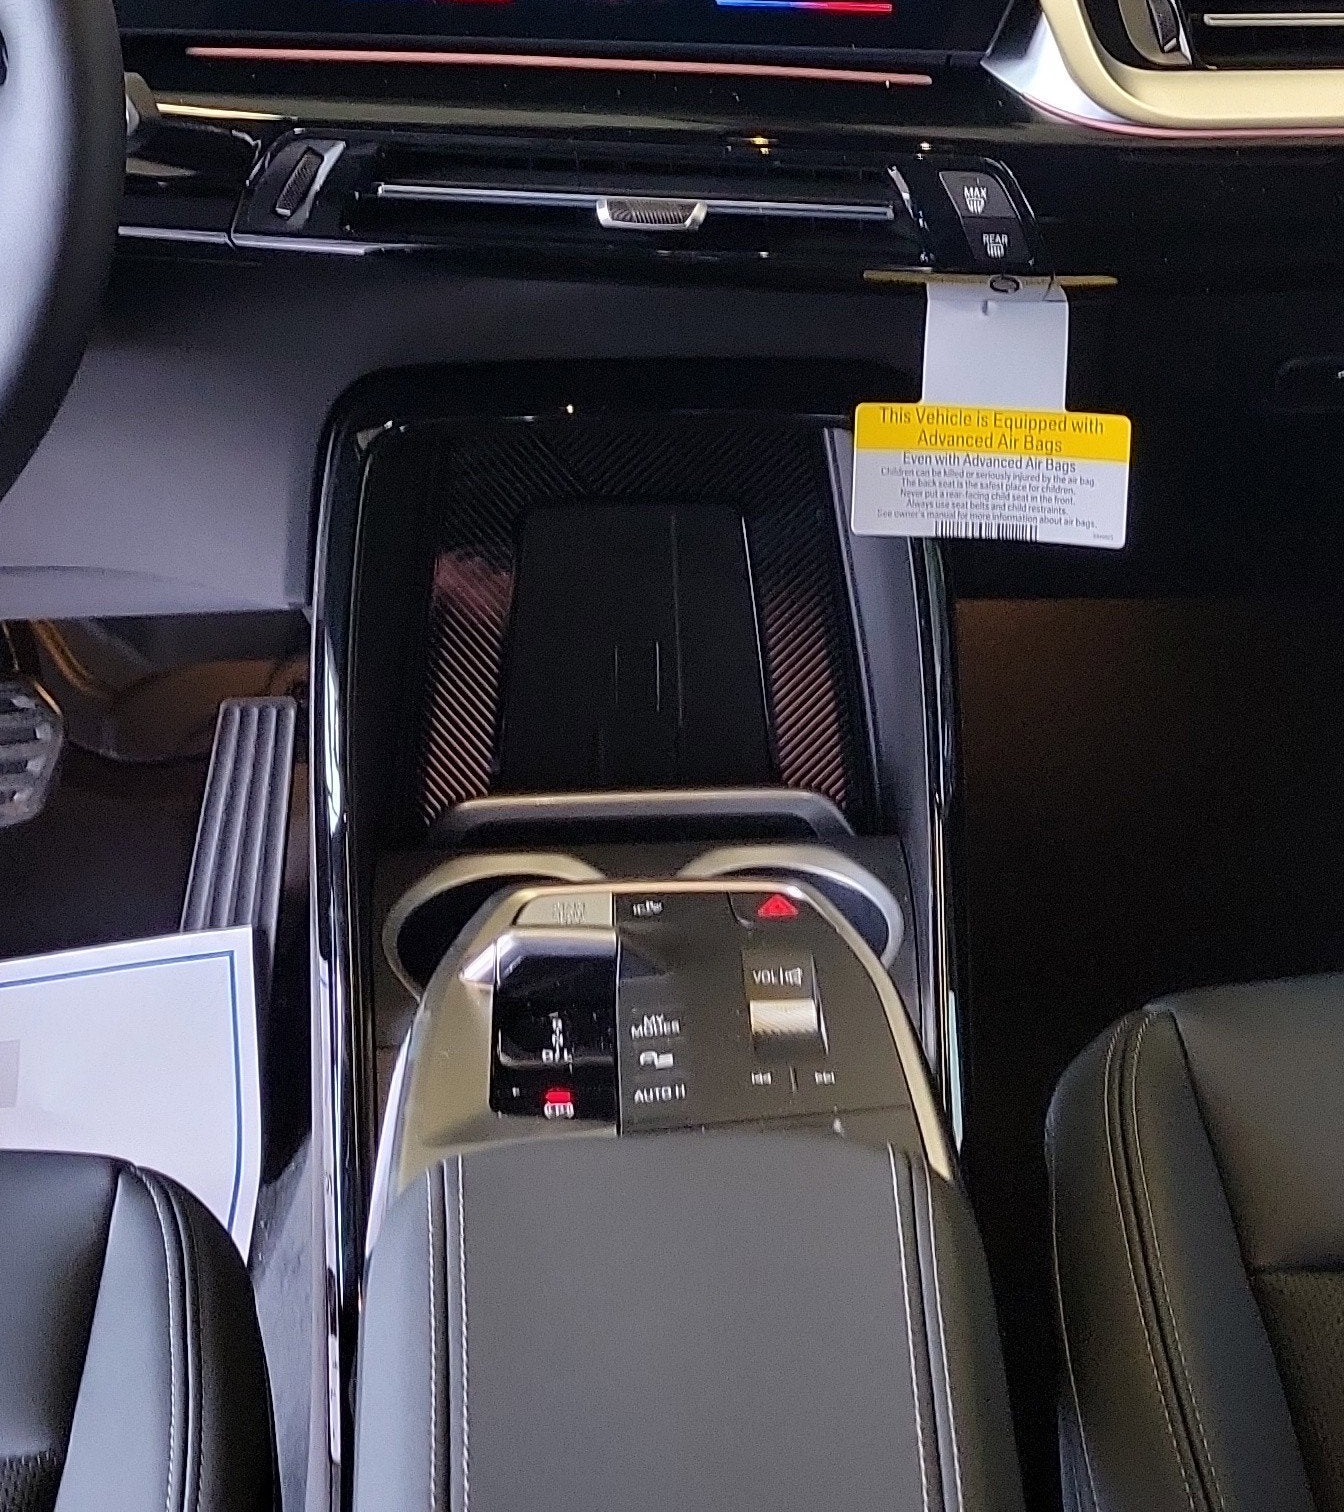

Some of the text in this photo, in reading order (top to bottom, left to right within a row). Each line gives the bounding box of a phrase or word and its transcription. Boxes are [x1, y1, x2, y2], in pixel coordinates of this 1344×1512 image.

[964, 186, 987, 200] MAX
[982, 233, 1008, 247] REAR
[879, 406, 1104, 434] This Vehicle is Equipped with
[917, 429, 1063, 455] Advanced Air Bags
[903, 451, 1077, 475] Even with Advanced Air Bags
[881, 466, 914, 477] Children
[915, 468, 930, 477] can
[931, 468, 942, 478] be
[943, 468, 965, 479] killed
[966, 470, 974, 479] or
[976, 470, 1010, 482] seriously
[1012, 471, 1040, 483] injured
[1041, 473, 1051, 486] by
[1053, 474, 1066, 484] the
[1068, 475, 1077, 485] air
[902, 478, 1076, 496] The back seat is the safest place for children.
[900, 488, 923, 498] Never
[924, 489, 938, 500] put
[991, 492, 1010, 502] child
[1012, 493, 1029, 503] seat
[1030, 494, 1038, 503] in
[1039, 494, 1053, 504] the
[1054, 494, 1076, 506] front.
[906, 498, 1068, 516] Always use seat belts and child restraints.
[926, 510, 955, 520] manual
[957, 511, 968, 521] for
[969, 512, 991, 520] more
[992, 513, 1038, 524] information
[1039, 515, 1062, 526] about
[1064, 517, 1074, 526] air
[752, 969, 778, 985] VOL
[634, 1085, 672, 1104] AUTO
